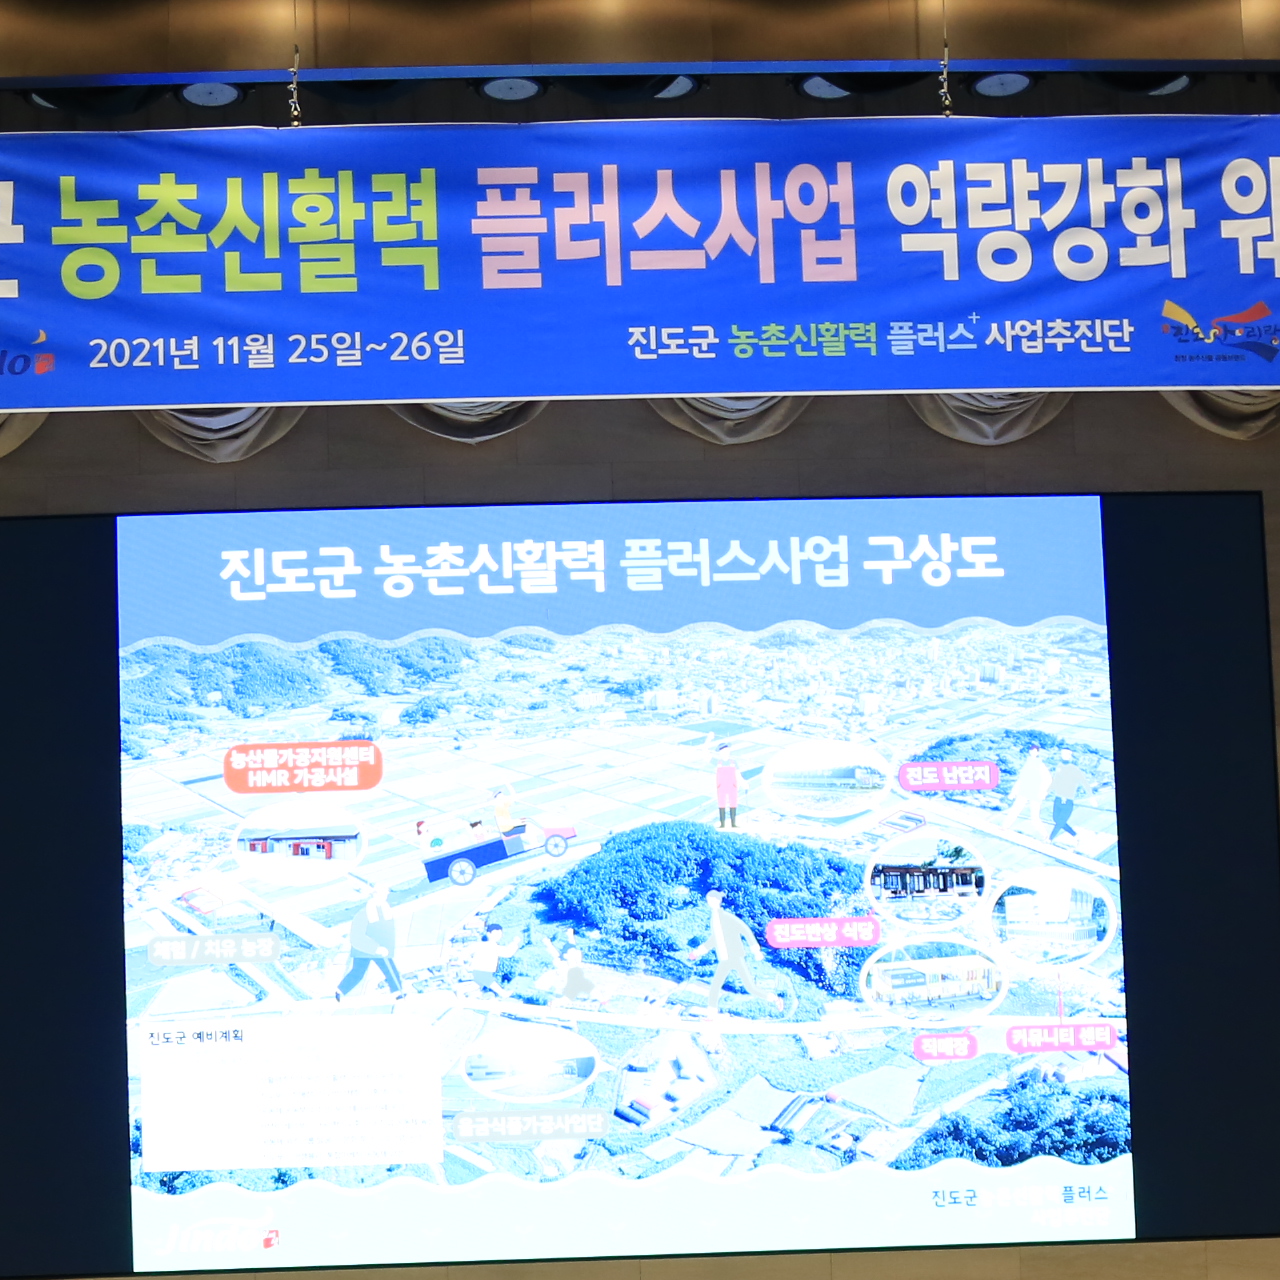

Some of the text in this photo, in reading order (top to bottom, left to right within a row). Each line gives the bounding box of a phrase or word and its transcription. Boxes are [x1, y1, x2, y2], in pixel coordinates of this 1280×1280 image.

[52, 167, 439, 299] 농촌신활력
[471, 162, 857, 289] 플러스사업
[887, 157, 1195, 282] 역량강화
[89, 336, 200, 370] 2021년
[212, 334, 275, 369] 11월
[288, 329, 465, 368] 25일~26일
[628, 325, 720, 360] 진도군
[728, 321, 878, 359] 농촌신활력
[985, 319, 1135, 354] 사업추진단
[220, 533, 1005, 601] 진도군 농촌신활력 플러스사업 구상도
[248, 769, 290, 787] HMR
[906, 766, 940, 785] 진도
[204, 938, 237, 958] 치유
[149, 1029, 243, 1046] 진도군 예비계획
[1078, 1026, 1111, 1046] 센터
[932, 1188, 978, 1208] 진도군
[1062, 1184, 1109, 1204] 플러스
